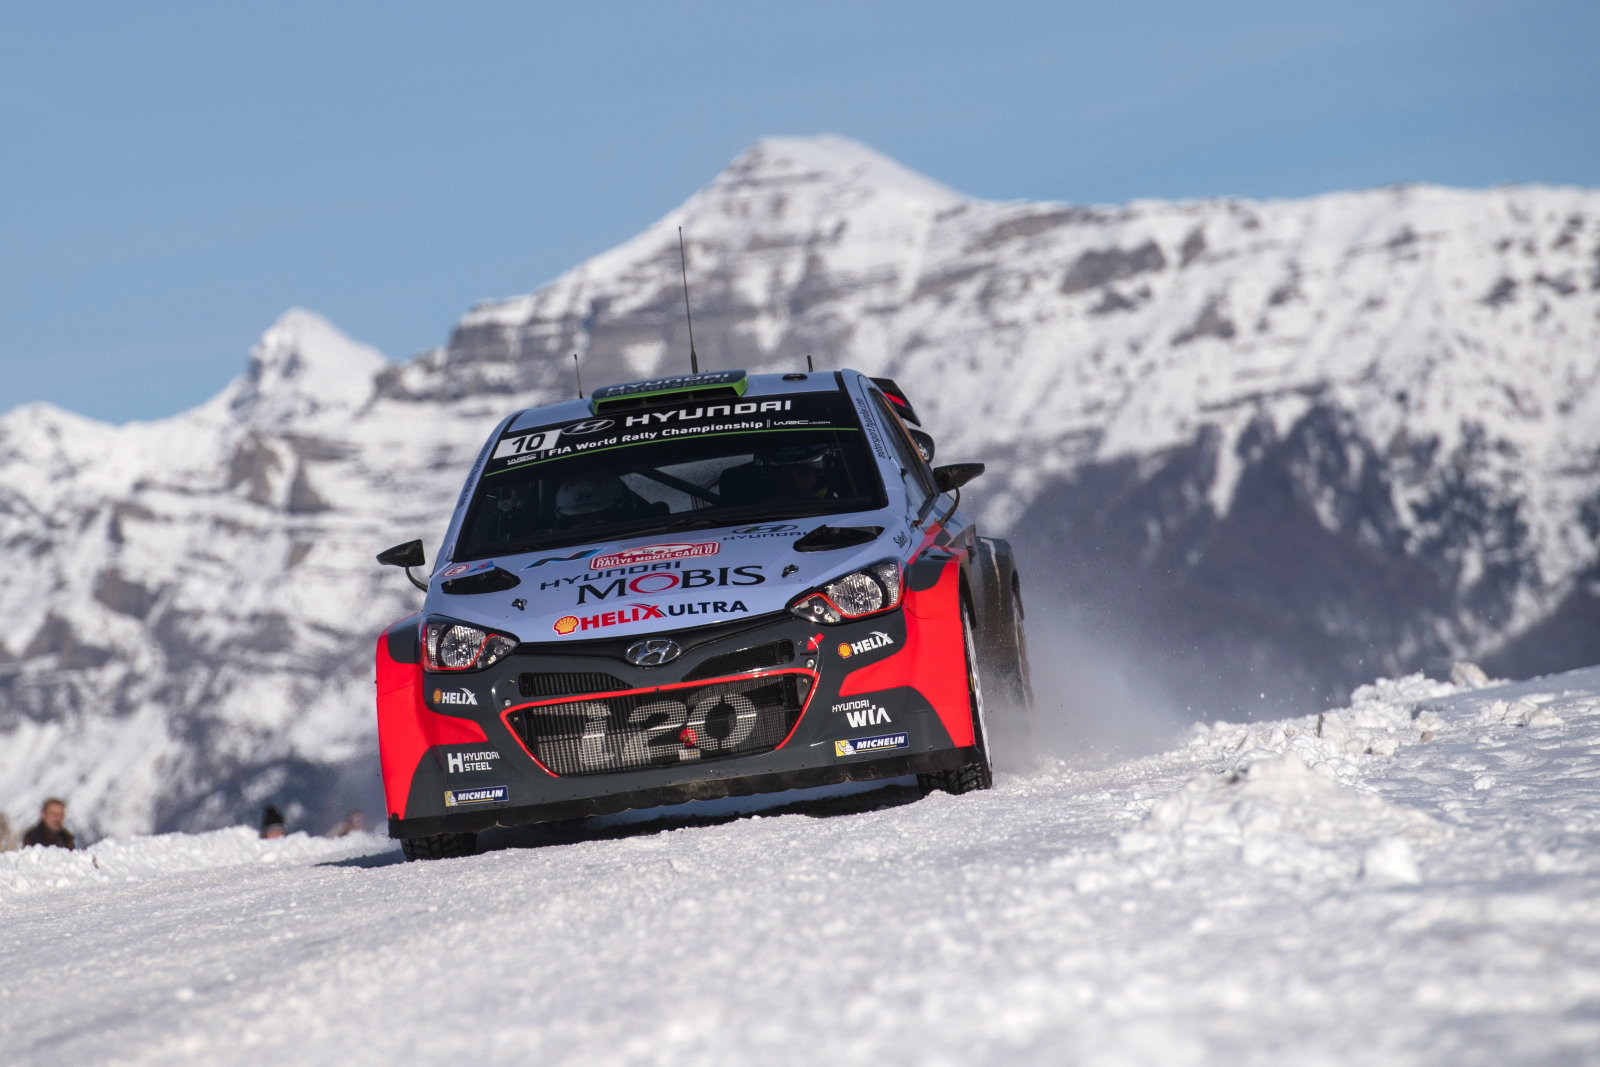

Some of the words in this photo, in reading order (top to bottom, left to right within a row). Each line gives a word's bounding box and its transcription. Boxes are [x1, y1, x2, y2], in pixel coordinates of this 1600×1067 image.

[608, 373, 729, 392] HYUNDAI
[625, 400, 792, 427] HYUNDAI
[511, 433, 547, 454] 10
[549, 446, 572, 457] FIA
[576, 436, 617, 450] World
[621, 429, 658, 443] Rally
[662, 420, 764, 437] Championship
[596, 557, 633, 569] RALLYE
[540, 561, 681, 591] HYUNDAI
[576, 565, 766, 605] MOBIS
[580, 603, 667, 631] HELIX
[668, 600, 749, 617] ULTRA
[851, 631, 894, 655] HELIX
[441, 687, 478, 706] HELIX
[832, 699, 870, 713] HYUNDAI
[856, 735, 905, 750] MICHELIN
[463, 751, 500, 762] HYUNDAI
[464, 761, 493, 772] STEEL
[457, 789, 504, 801] MICHELIN
